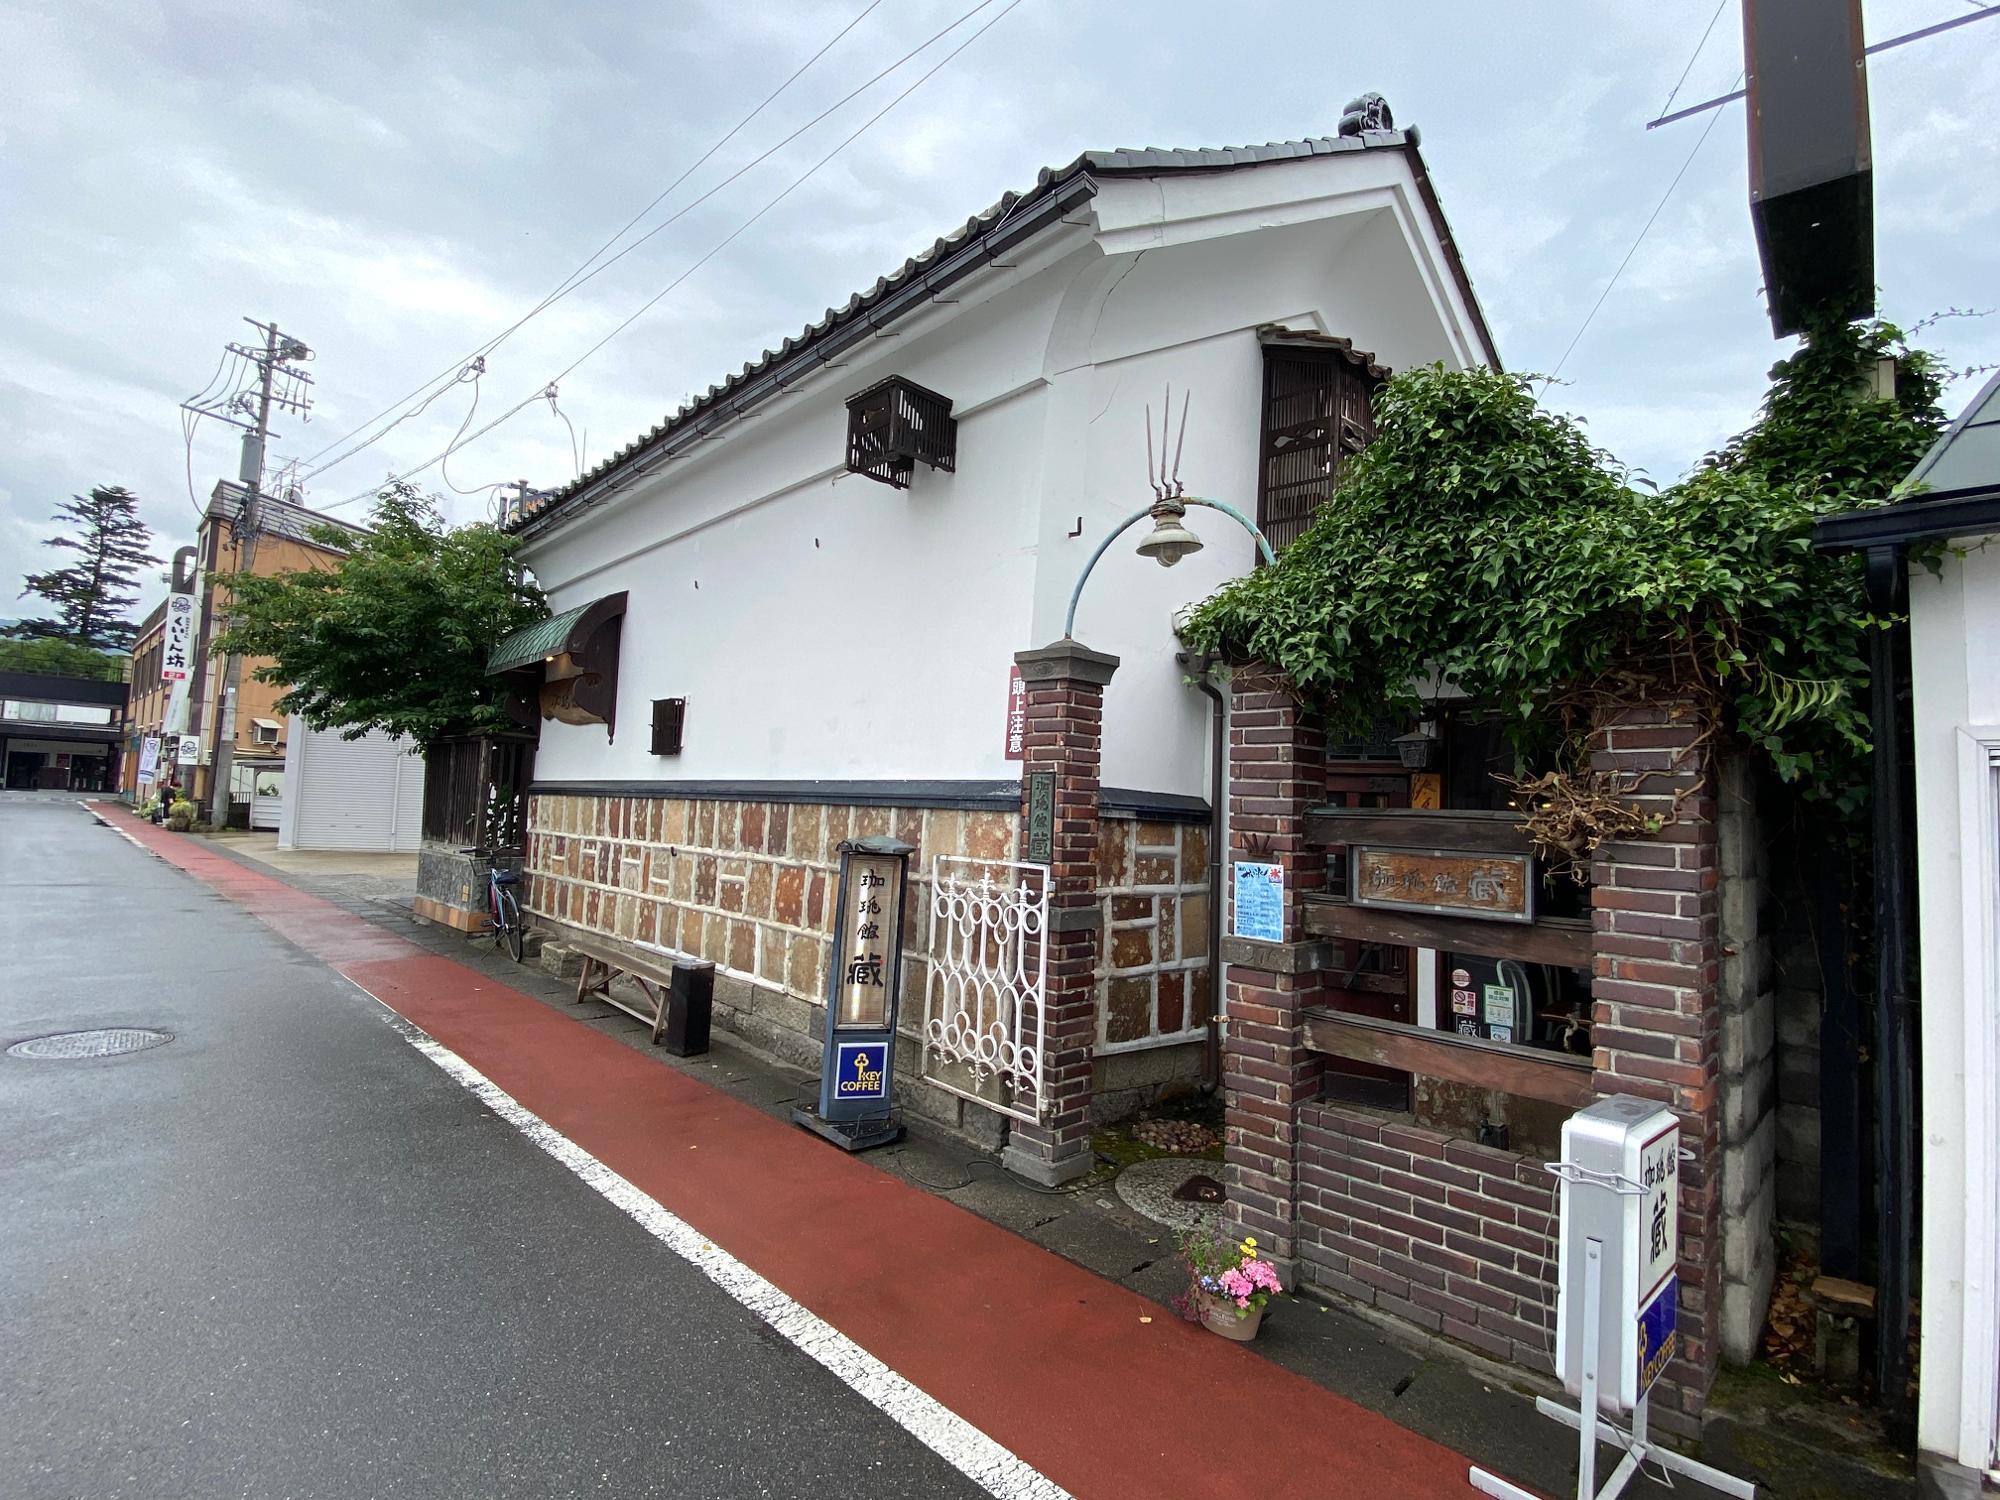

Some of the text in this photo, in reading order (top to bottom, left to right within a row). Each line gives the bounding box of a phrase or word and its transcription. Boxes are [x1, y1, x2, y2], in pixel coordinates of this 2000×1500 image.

[166, 616, 185, 668] くいしん坊
[1009, 677, 1026, 753] 頭上注意
[841, 1081, 880, 1091] COFFEE
[862, 1071, 882, 1080] KEY
